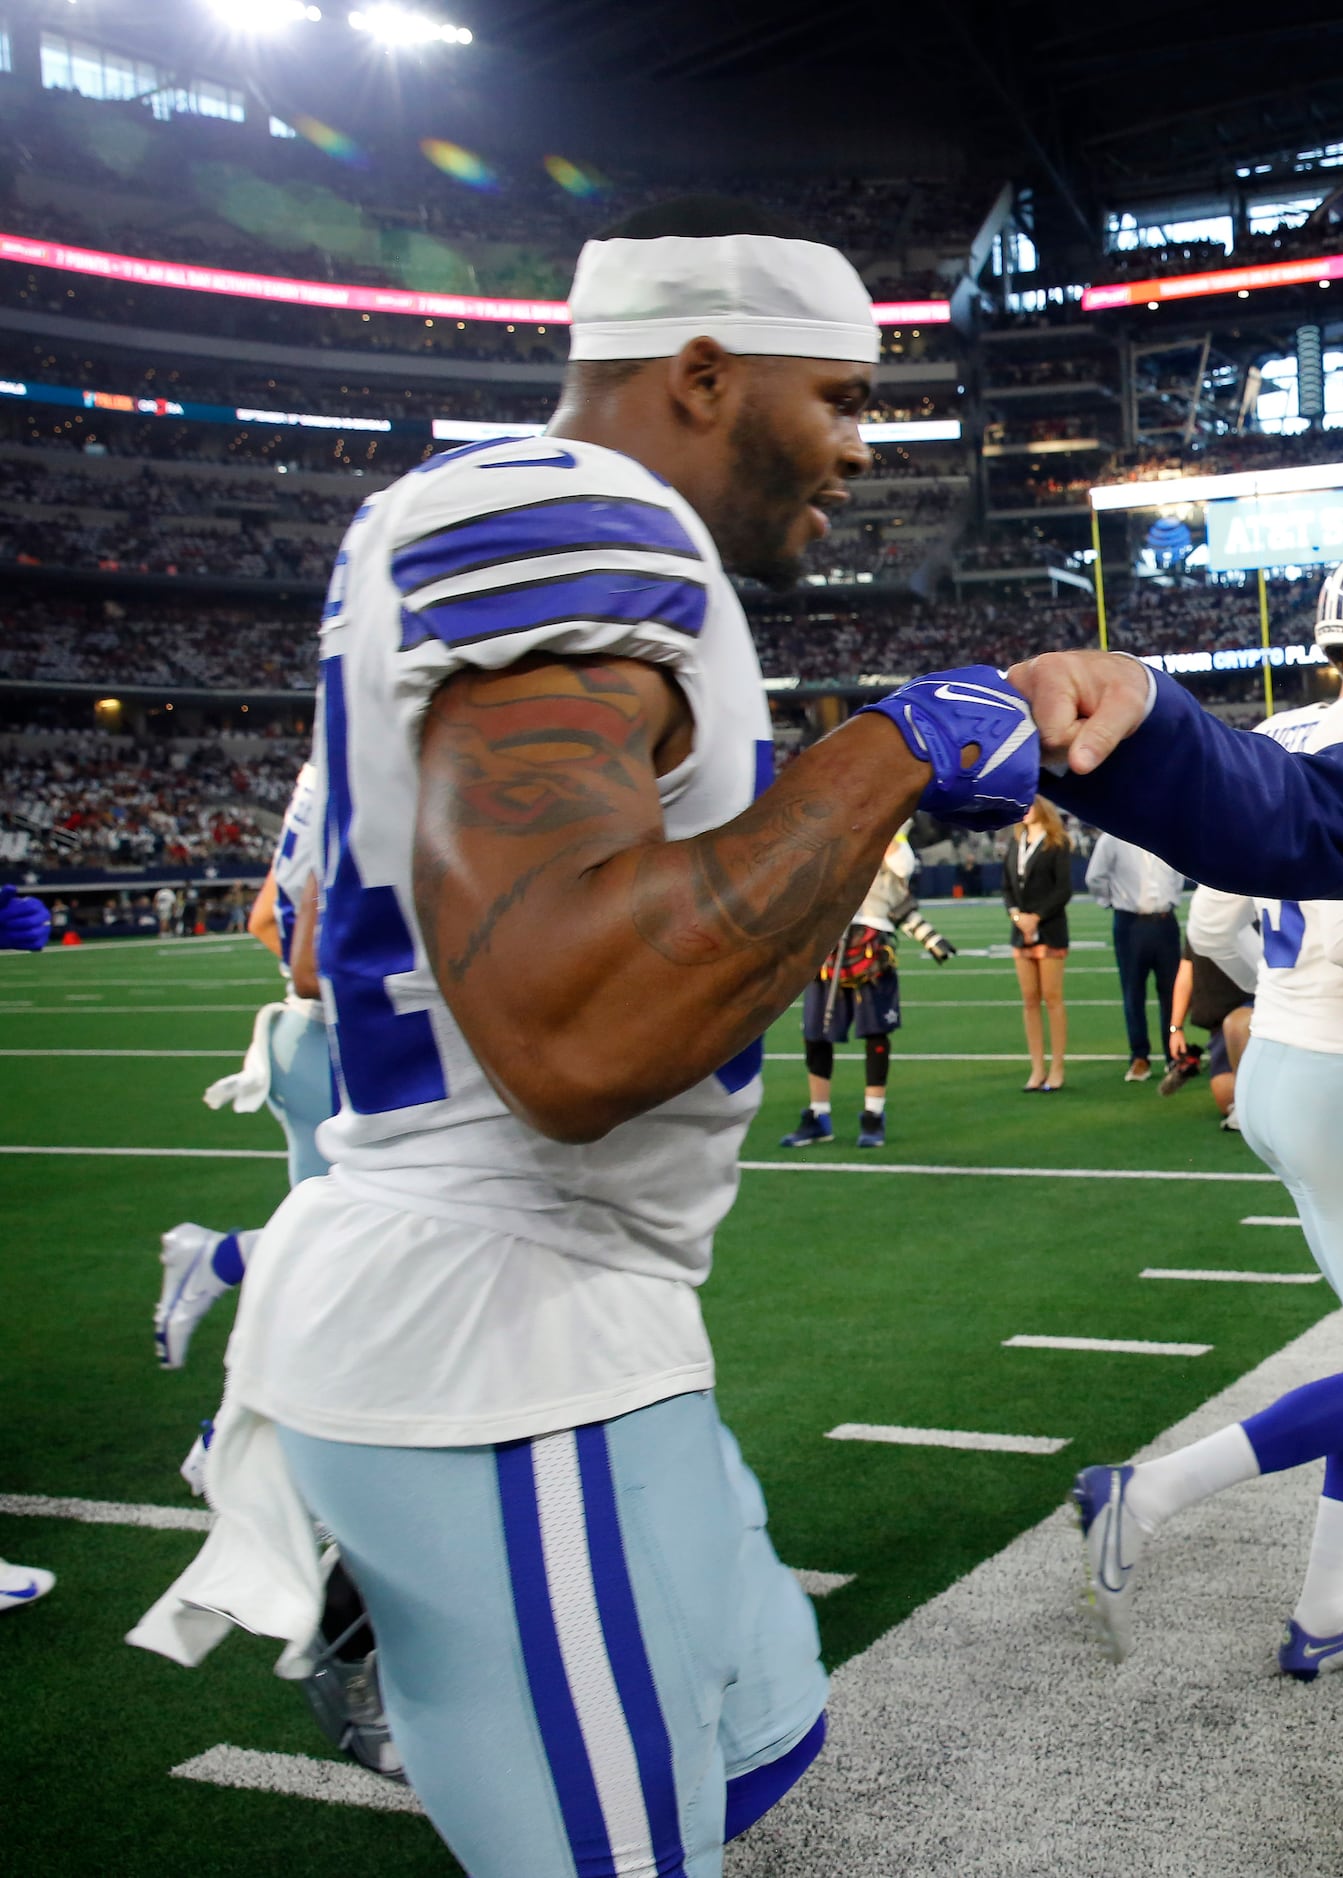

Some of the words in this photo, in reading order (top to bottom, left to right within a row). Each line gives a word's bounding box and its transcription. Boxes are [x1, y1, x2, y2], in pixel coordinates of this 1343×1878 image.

[1224, 509, 1316, 554] AT&T
[1164, 652, 1212, 674] YOUR
[1212, 646, 1285, 671] CRYPTO
[1285, 644, 1329, 666] PLA
